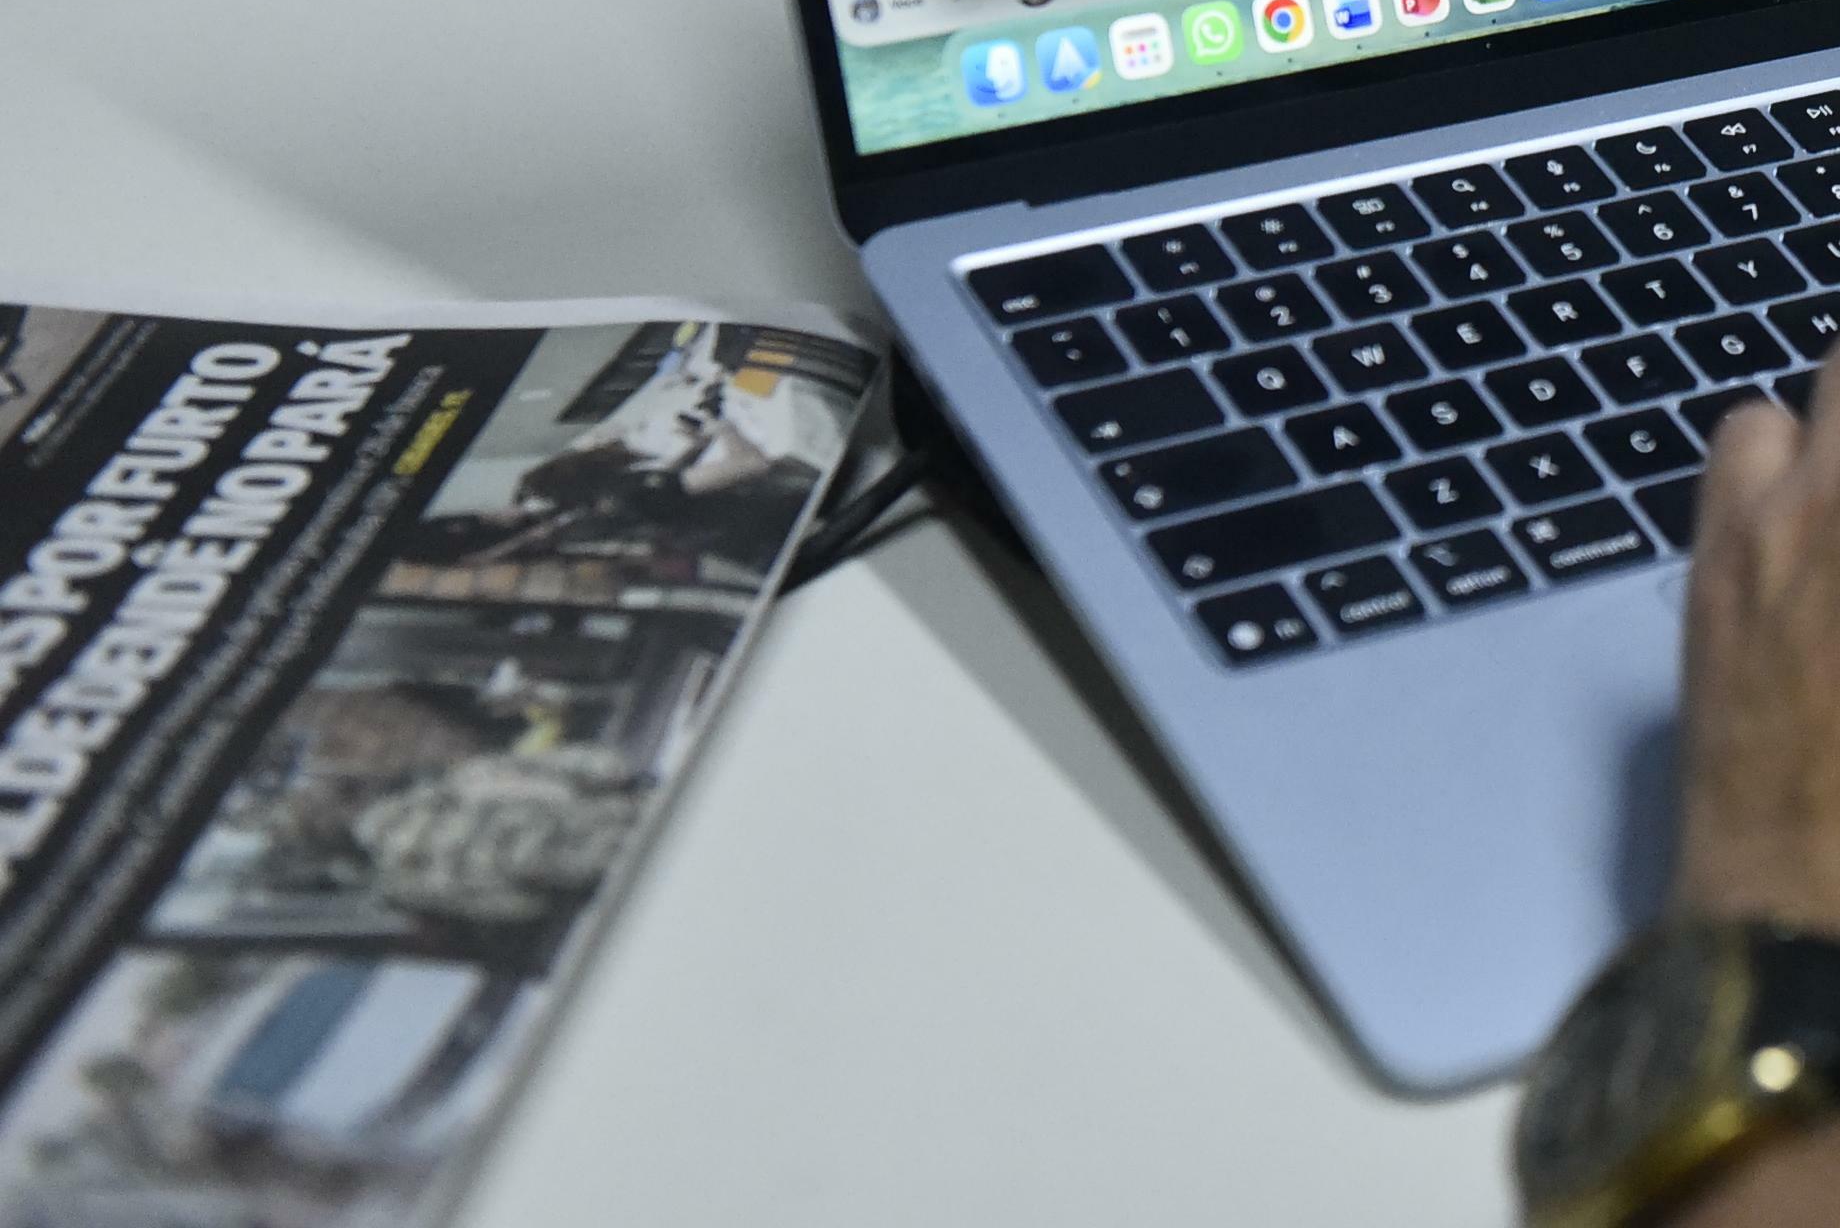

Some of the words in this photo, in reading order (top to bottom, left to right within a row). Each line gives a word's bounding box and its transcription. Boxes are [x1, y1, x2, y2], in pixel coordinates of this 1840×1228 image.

[1741, 202, 1759, 221] 7
[1652, 222, 1674, 241] 6
[1560, 242, 1583, 261] 5
[1469, 263, 1489, 281] 4
[1737, 259, 1758, 279] Y
[1368, 283, 1393, 304] 3
[1644, 279, 1666, 300] T
[1269, 305, 1294, 326] 2
[1551, 301, 1578, 322] R
[1456, 322, 1481, 345] E
[1811, 313, 1839, 334] H
[1351, 344, 1385, 367] W
[1626, 355, 1646, 378] F
[240, 332, 414, 463] PARÁ
[1528, 379, 1556, 402] D
[1430, 401, 1459, 425] S
[1332, 426, 1358, 450] A
[1629, 430, 1657, 454] C
[0, 499, 164, 613] POR
[84, 342, 282, 501] FURTO
[1529, 455, 1558, 479] X
[181, 462, 314, 540] NO
[1430, 478, 1457, 505] Z
[40, 537, 264, 710] DENDÊ
